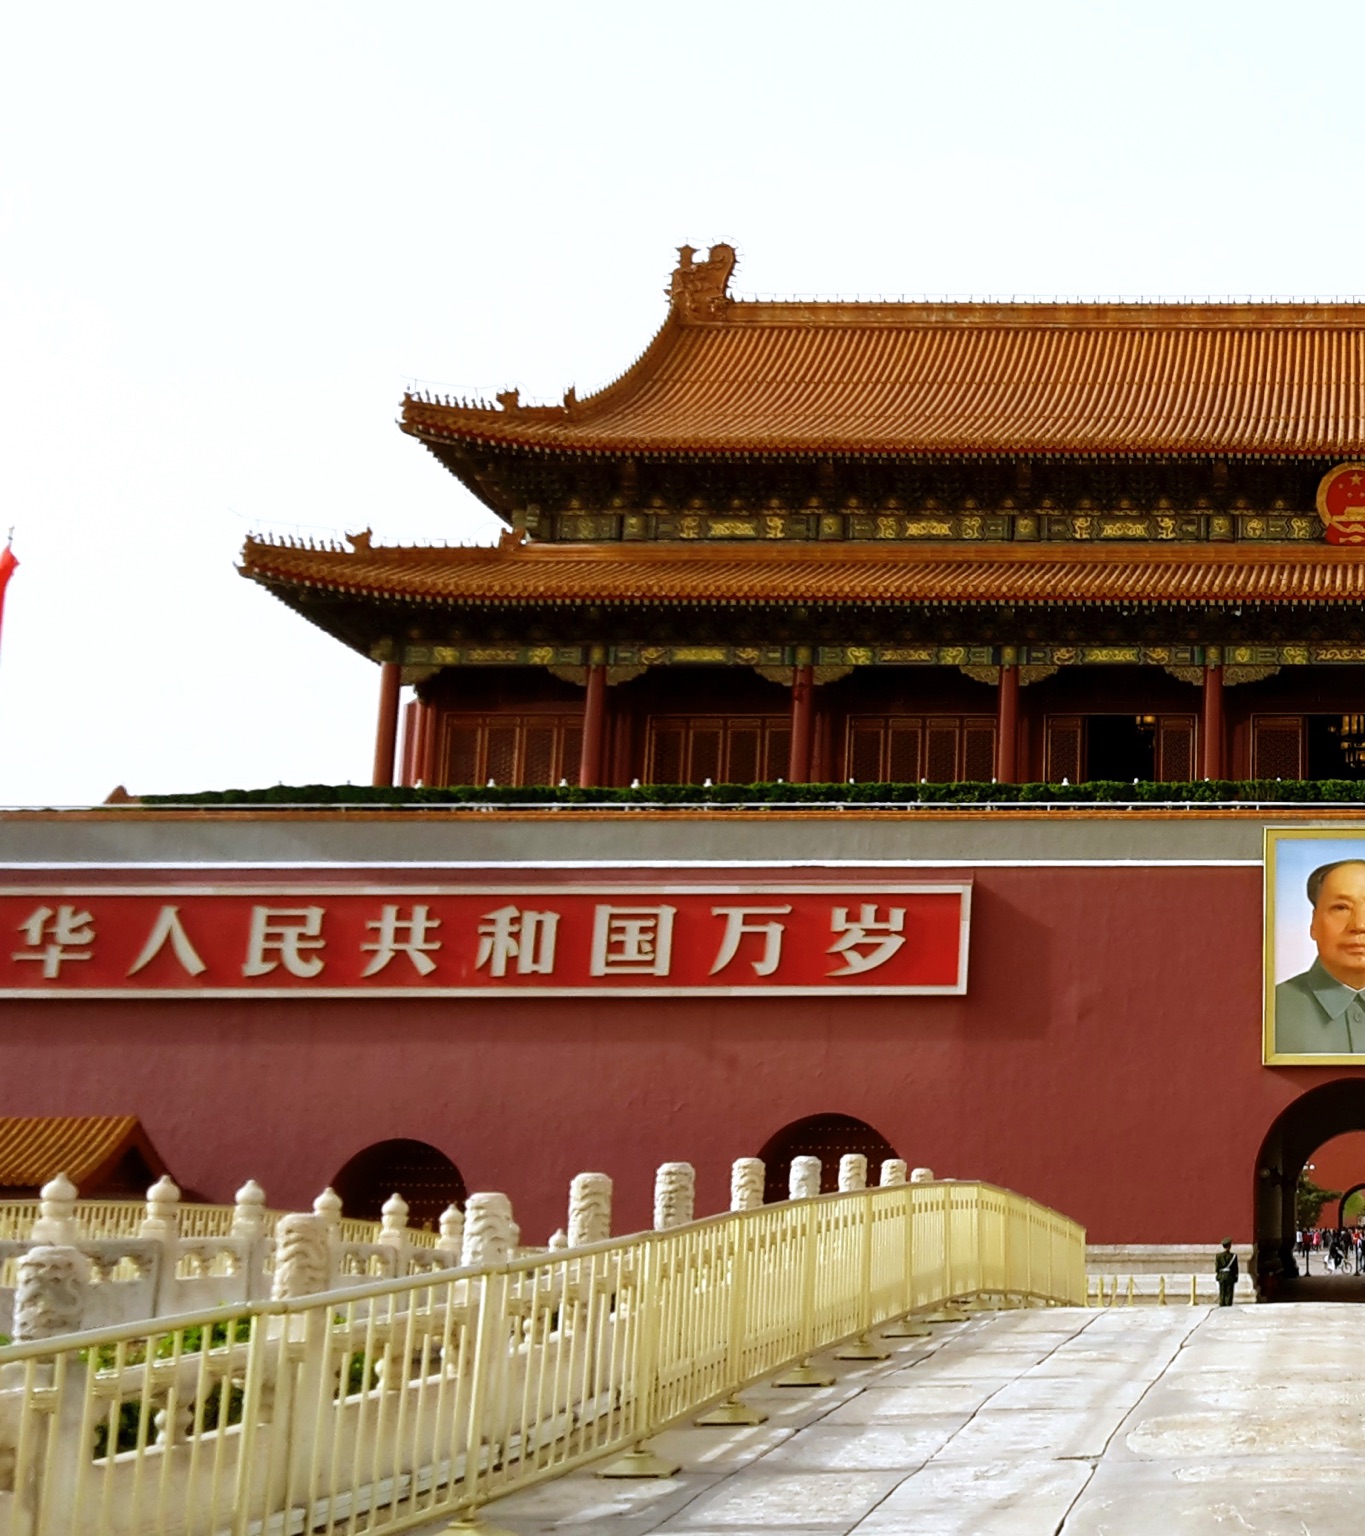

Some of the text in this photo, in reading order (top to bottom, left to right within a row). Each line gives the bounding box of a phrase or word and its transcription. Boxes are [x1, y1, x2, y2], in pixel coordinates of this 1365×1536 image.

[13, 904, 907, 978] 华人民共和国万岁
